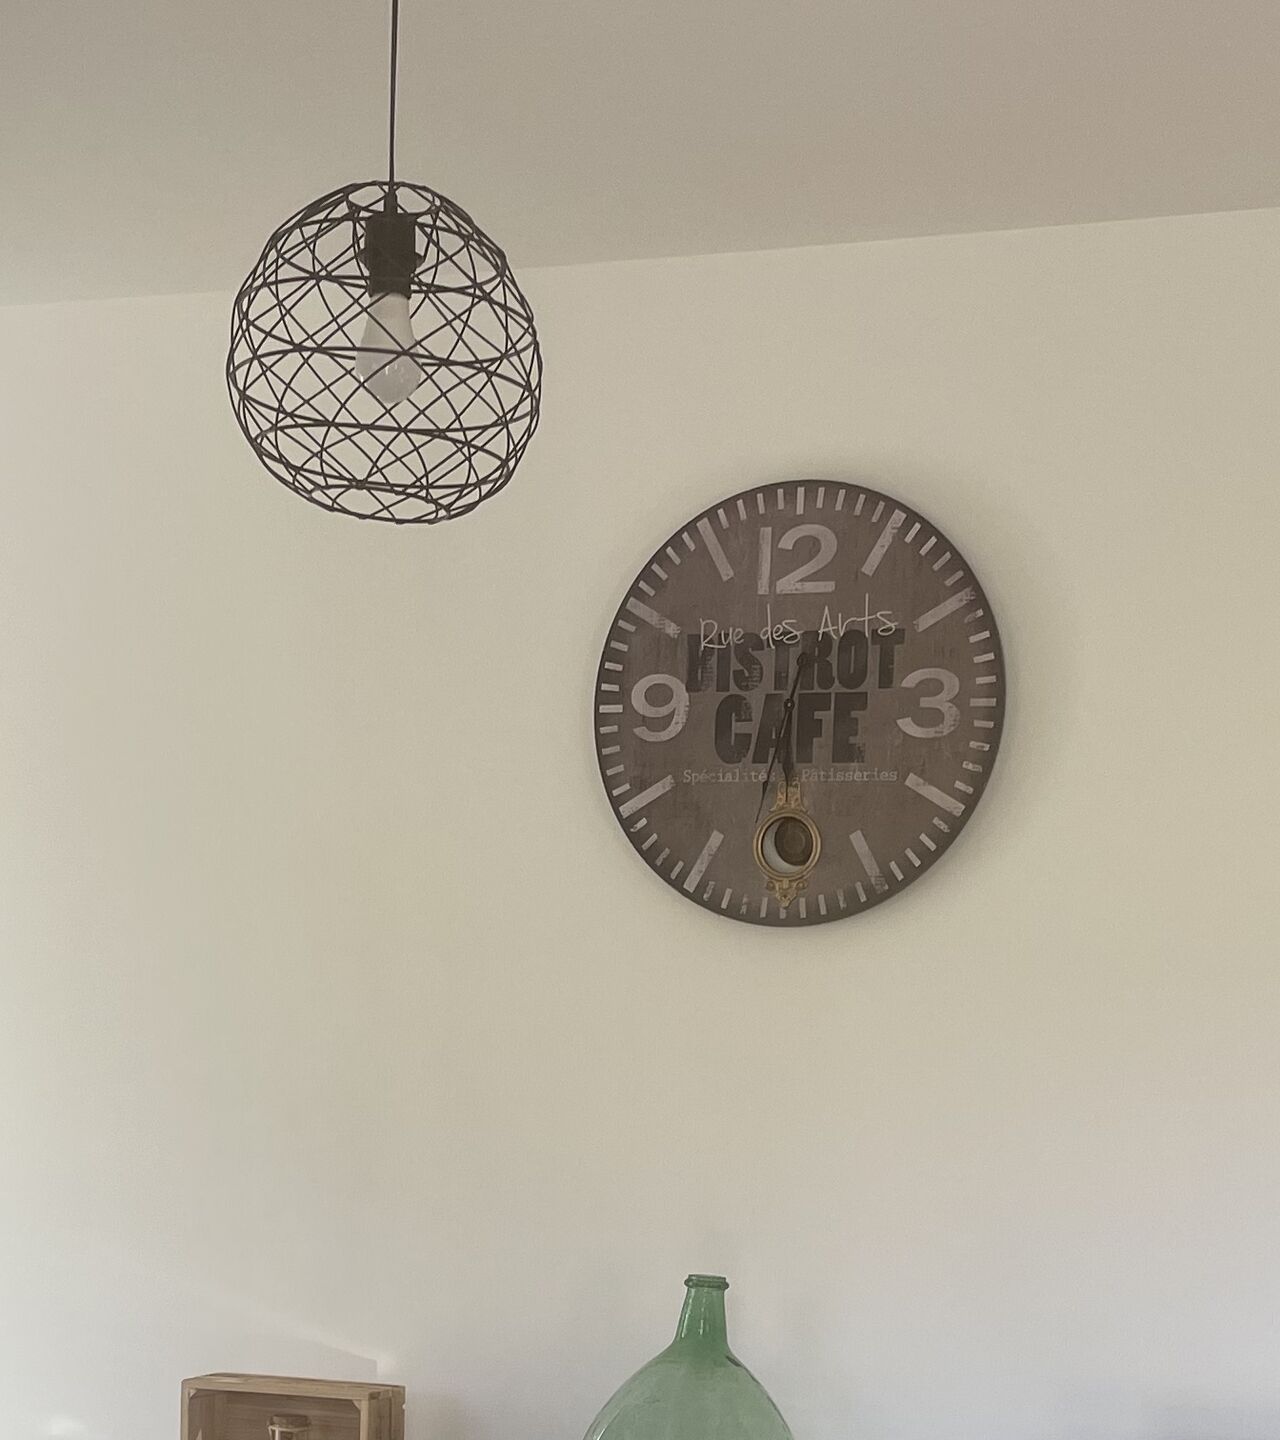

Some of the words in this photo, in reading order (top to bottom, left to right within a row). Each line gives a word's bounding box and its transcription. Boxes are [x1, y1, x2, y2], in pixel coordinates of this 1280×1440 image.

[757, 523, 839, 595] 12
[699, 618, 745, 650] Rue
[760, 603, 804, 649] des
[818, 592, 899, 641] Arts
[686, 628, 906, 692] BISTROT
[631, 673, 690, 742] 9
[896, 667, 961, 738] 3
